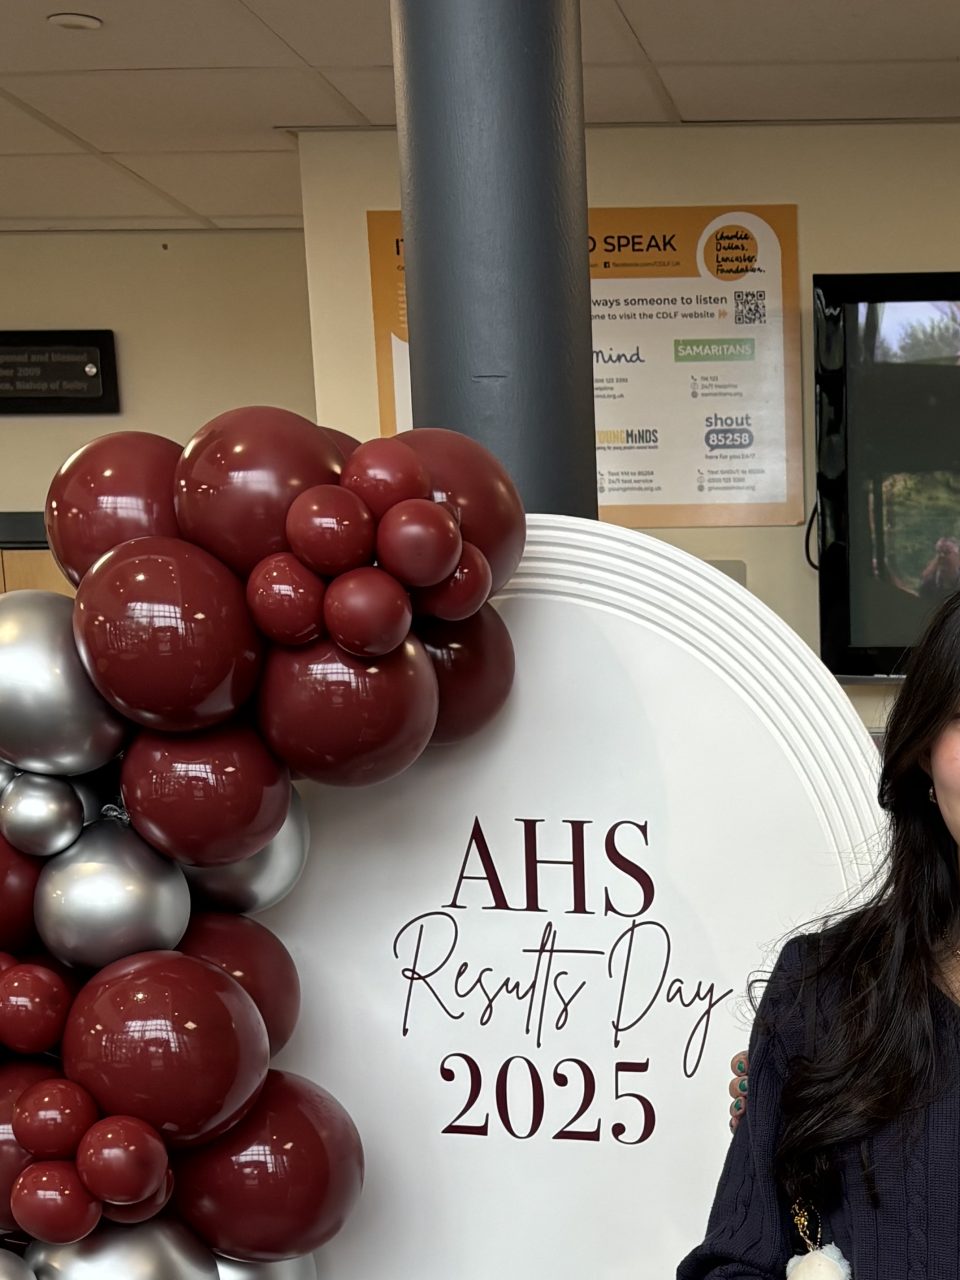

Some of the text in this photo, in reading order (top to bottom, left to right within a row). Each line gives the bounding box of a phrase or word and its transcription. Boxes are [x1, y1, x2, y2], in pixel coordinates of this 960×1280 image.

[603, 234, 677, 253] SPEAK
[623, 296, 678, 307] someone
[680, 296, 693, 306] to
[695, 293, 728, 306] listen
[608, 312, 617, 320] to
[618, 311, 637, 320] visit
[638, 310, 654, 320] the
[655, 310, 679, 320] CDLF
[681, 309, 715, 320] website
[677, 344, 751, 357] SAMARITANS
[705, 413, 752, 428] shout
[708, 432, 750, 446] 85258
[441, 815, 656, 918] AHS
[393, 911, 734, 1079] Results Day
[439, 1052, 657, 1146] 2025
